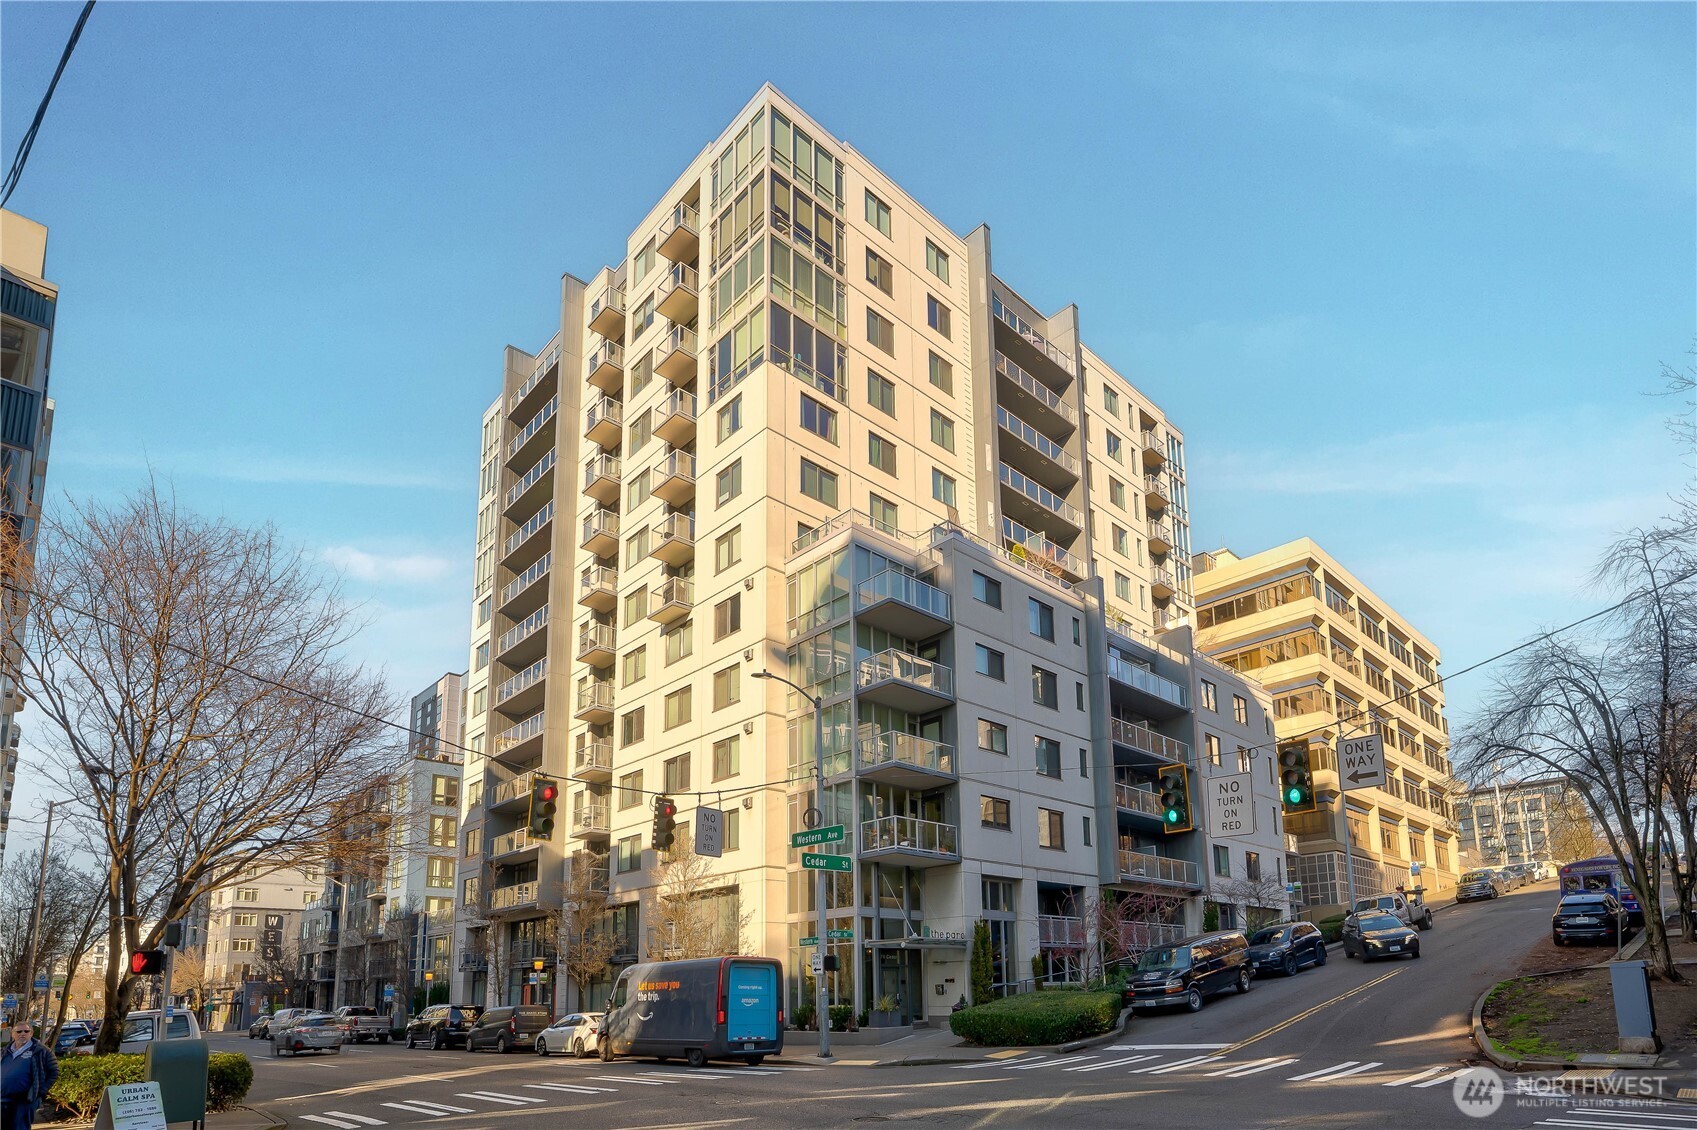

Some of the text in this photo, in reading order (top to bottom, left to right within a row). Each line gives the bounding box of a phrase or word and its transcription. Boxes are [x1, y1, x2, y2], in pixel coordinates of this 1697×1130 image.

[1345, 740, 1374, 755] ONE
[1345, 753, 1376, 769] WAY
[1219, 781, 1240, 794] NO
[1217, 795, 1243, 806] TURN
[704, 812, 716, 823] NO
[1224, 809, 1238, 818] ON
[701, 823, 717, 833] TURN
[1222, 821, 1241, 831] RED
[796, 831, 838, 845] Western Ave
[702, 843, 715, 851] RED
[805, 856, 849, 869] Cedar St
[931, 929, 944, 939] the
[637, 981, 680, 991] Let us save you
[637, 991, 660, 1002] the trip.
